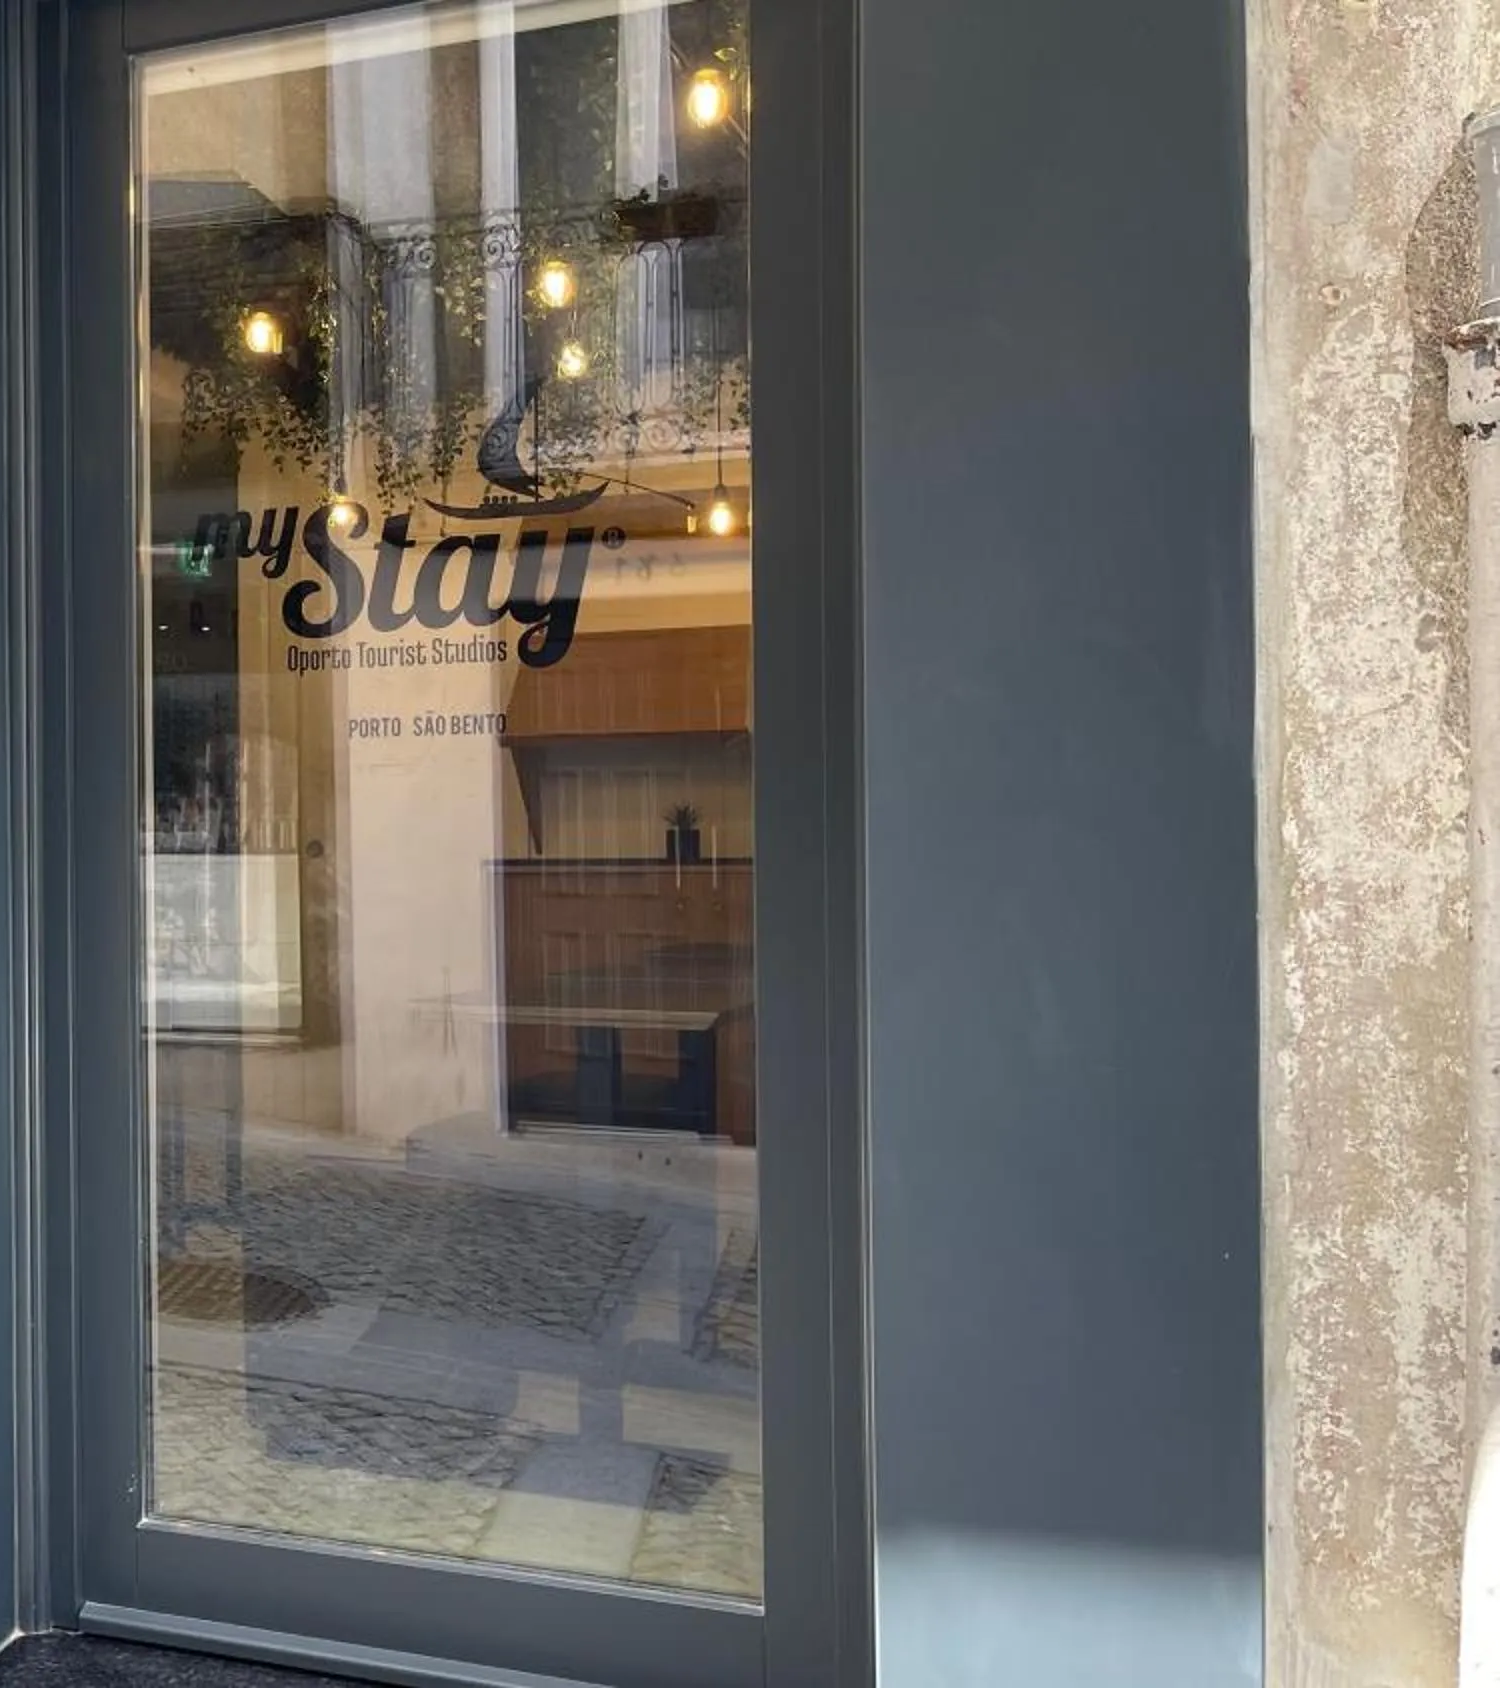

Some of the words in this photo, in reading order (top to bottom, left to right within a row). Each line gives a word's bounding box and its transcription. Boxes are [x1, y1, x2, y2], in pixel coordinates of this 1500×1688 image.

[287, 645, 351, 677] Oporto
[357, 640, 426, 669] Tourist
[431, 635, 508, 664] Studios
[349, 717, 401, 738] PORTO
[413, 711, 446, 737] SÃO
[451, 713, 507, 735] BENTO
